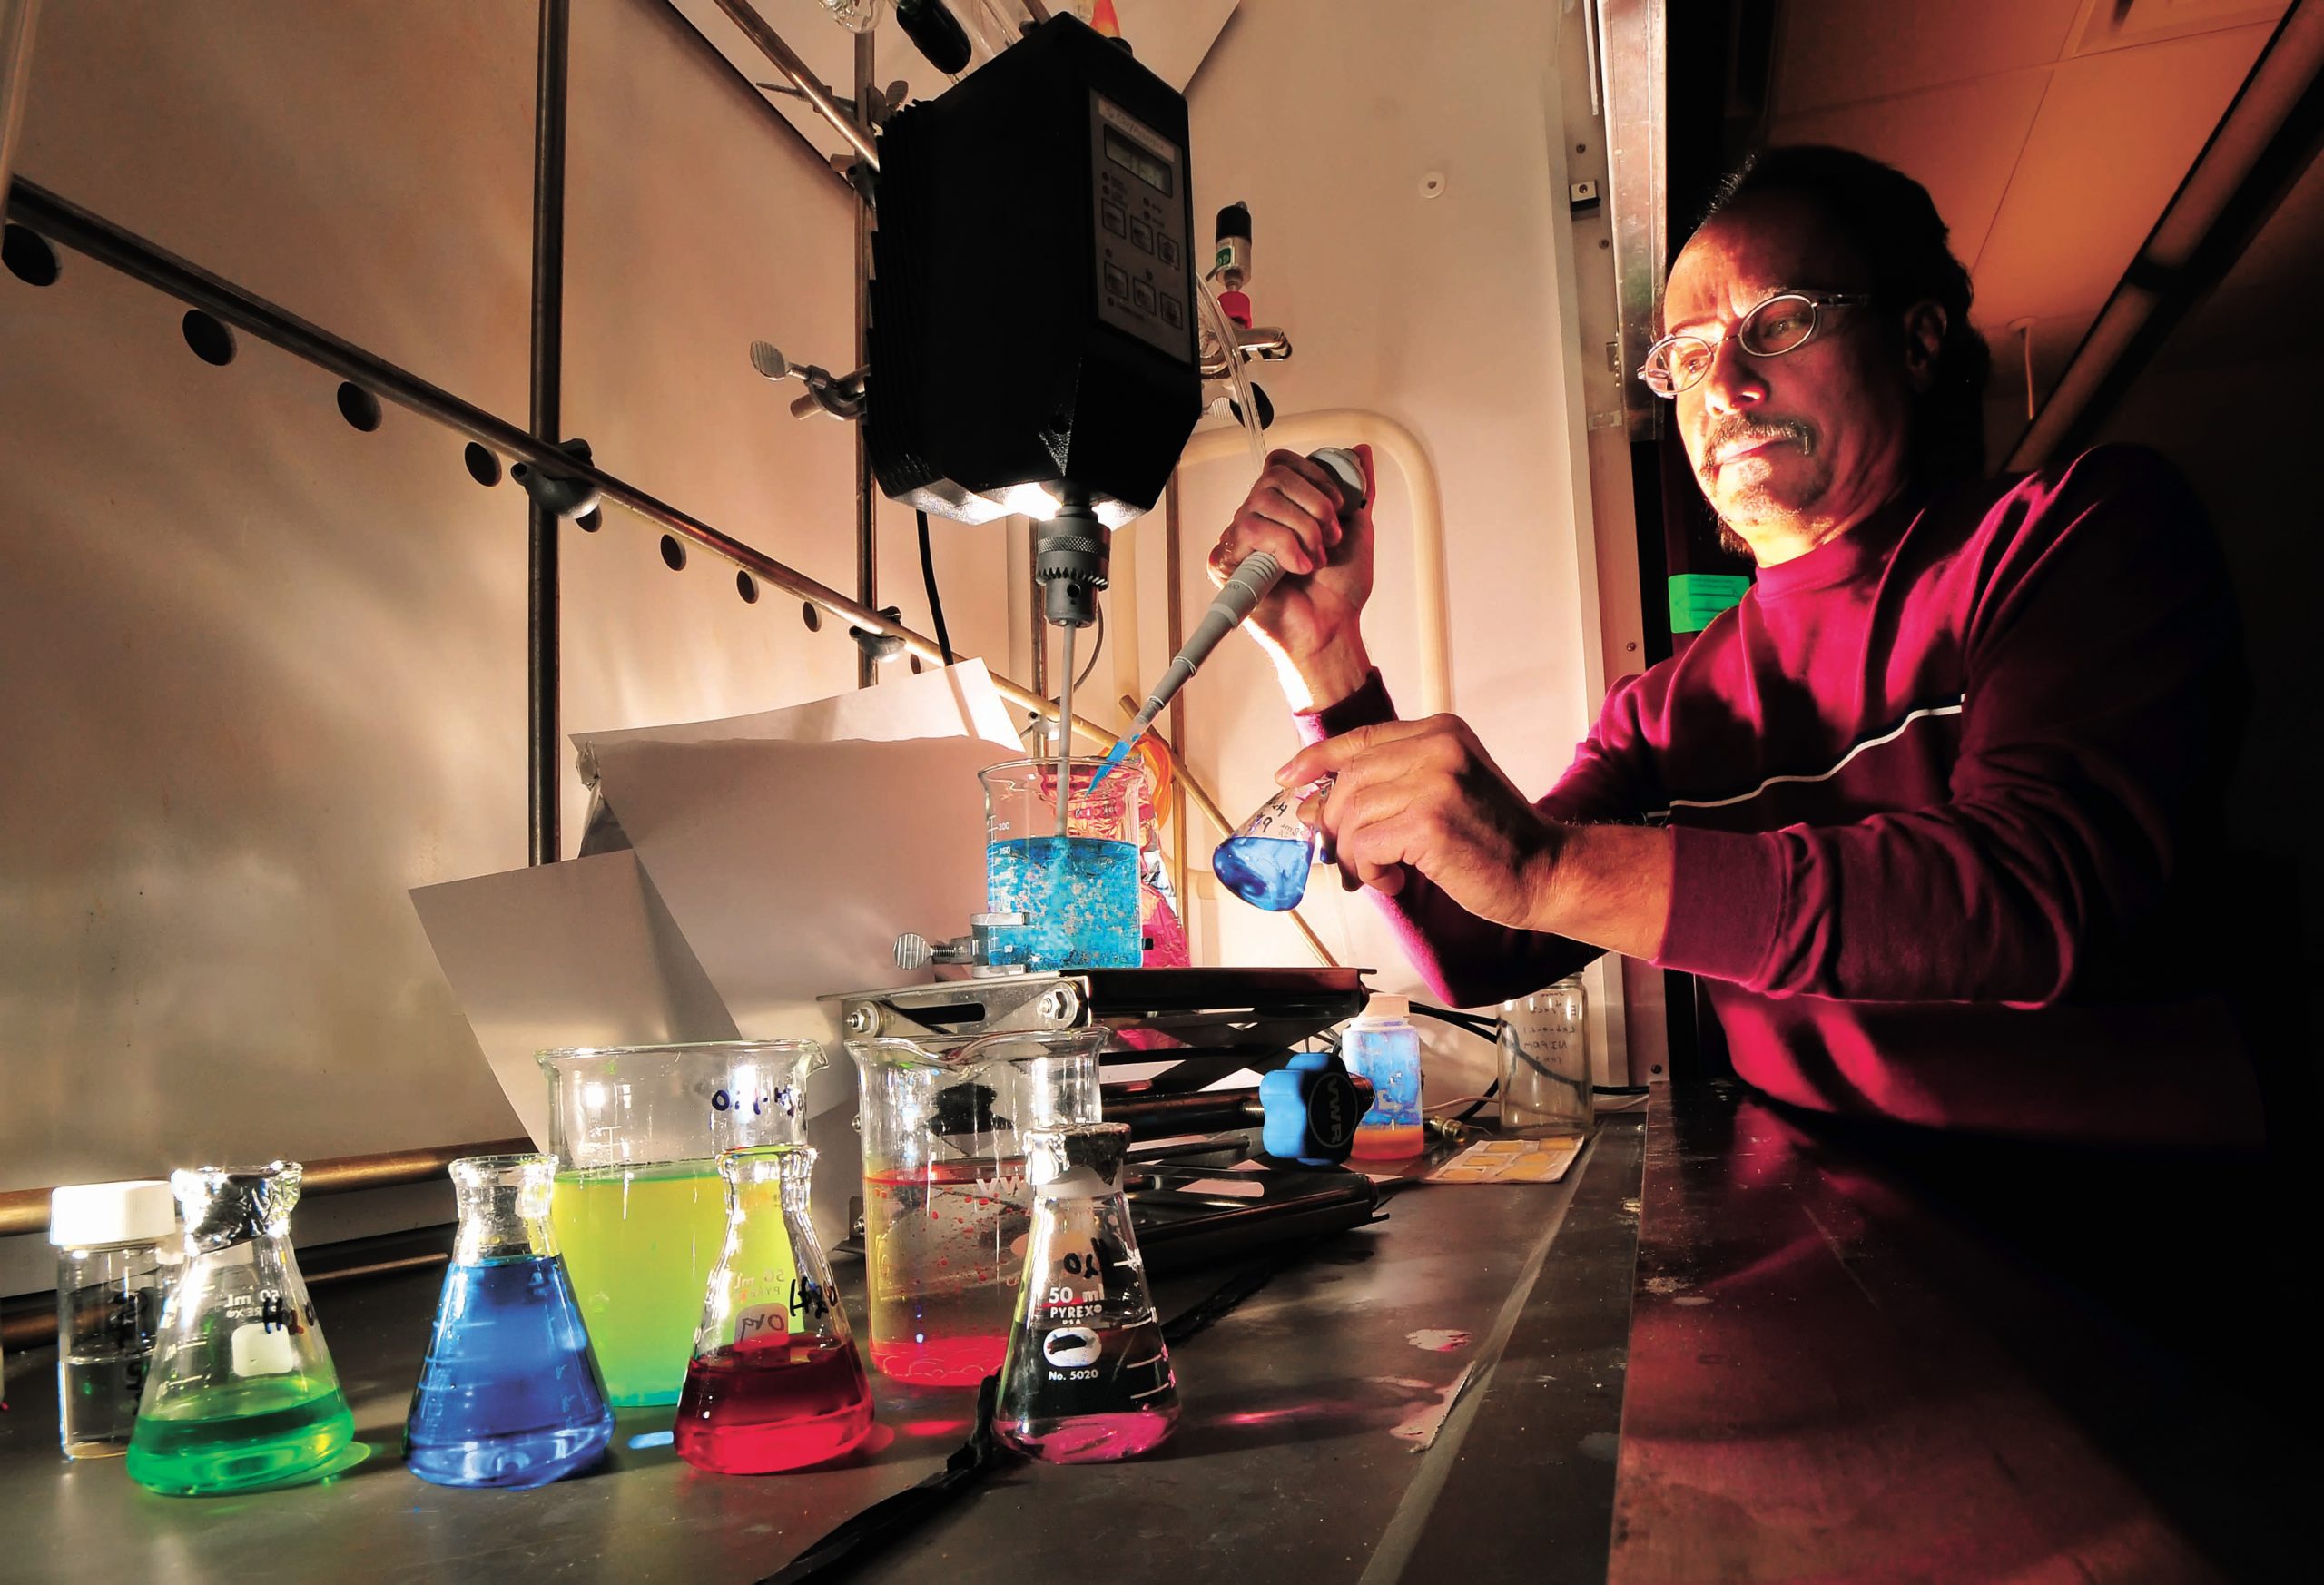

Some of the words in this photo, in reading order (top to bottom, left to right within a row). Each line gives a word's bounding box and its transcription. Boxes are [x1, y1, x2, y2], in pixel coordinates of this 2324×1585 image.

[1327, 1075, 1342, 1144] VWR
[1049, 1286, 1073, 1304] 50
[1048, 1371, 1067, 1381] No.
[1069, 1369, 1099, 1381] 5020
